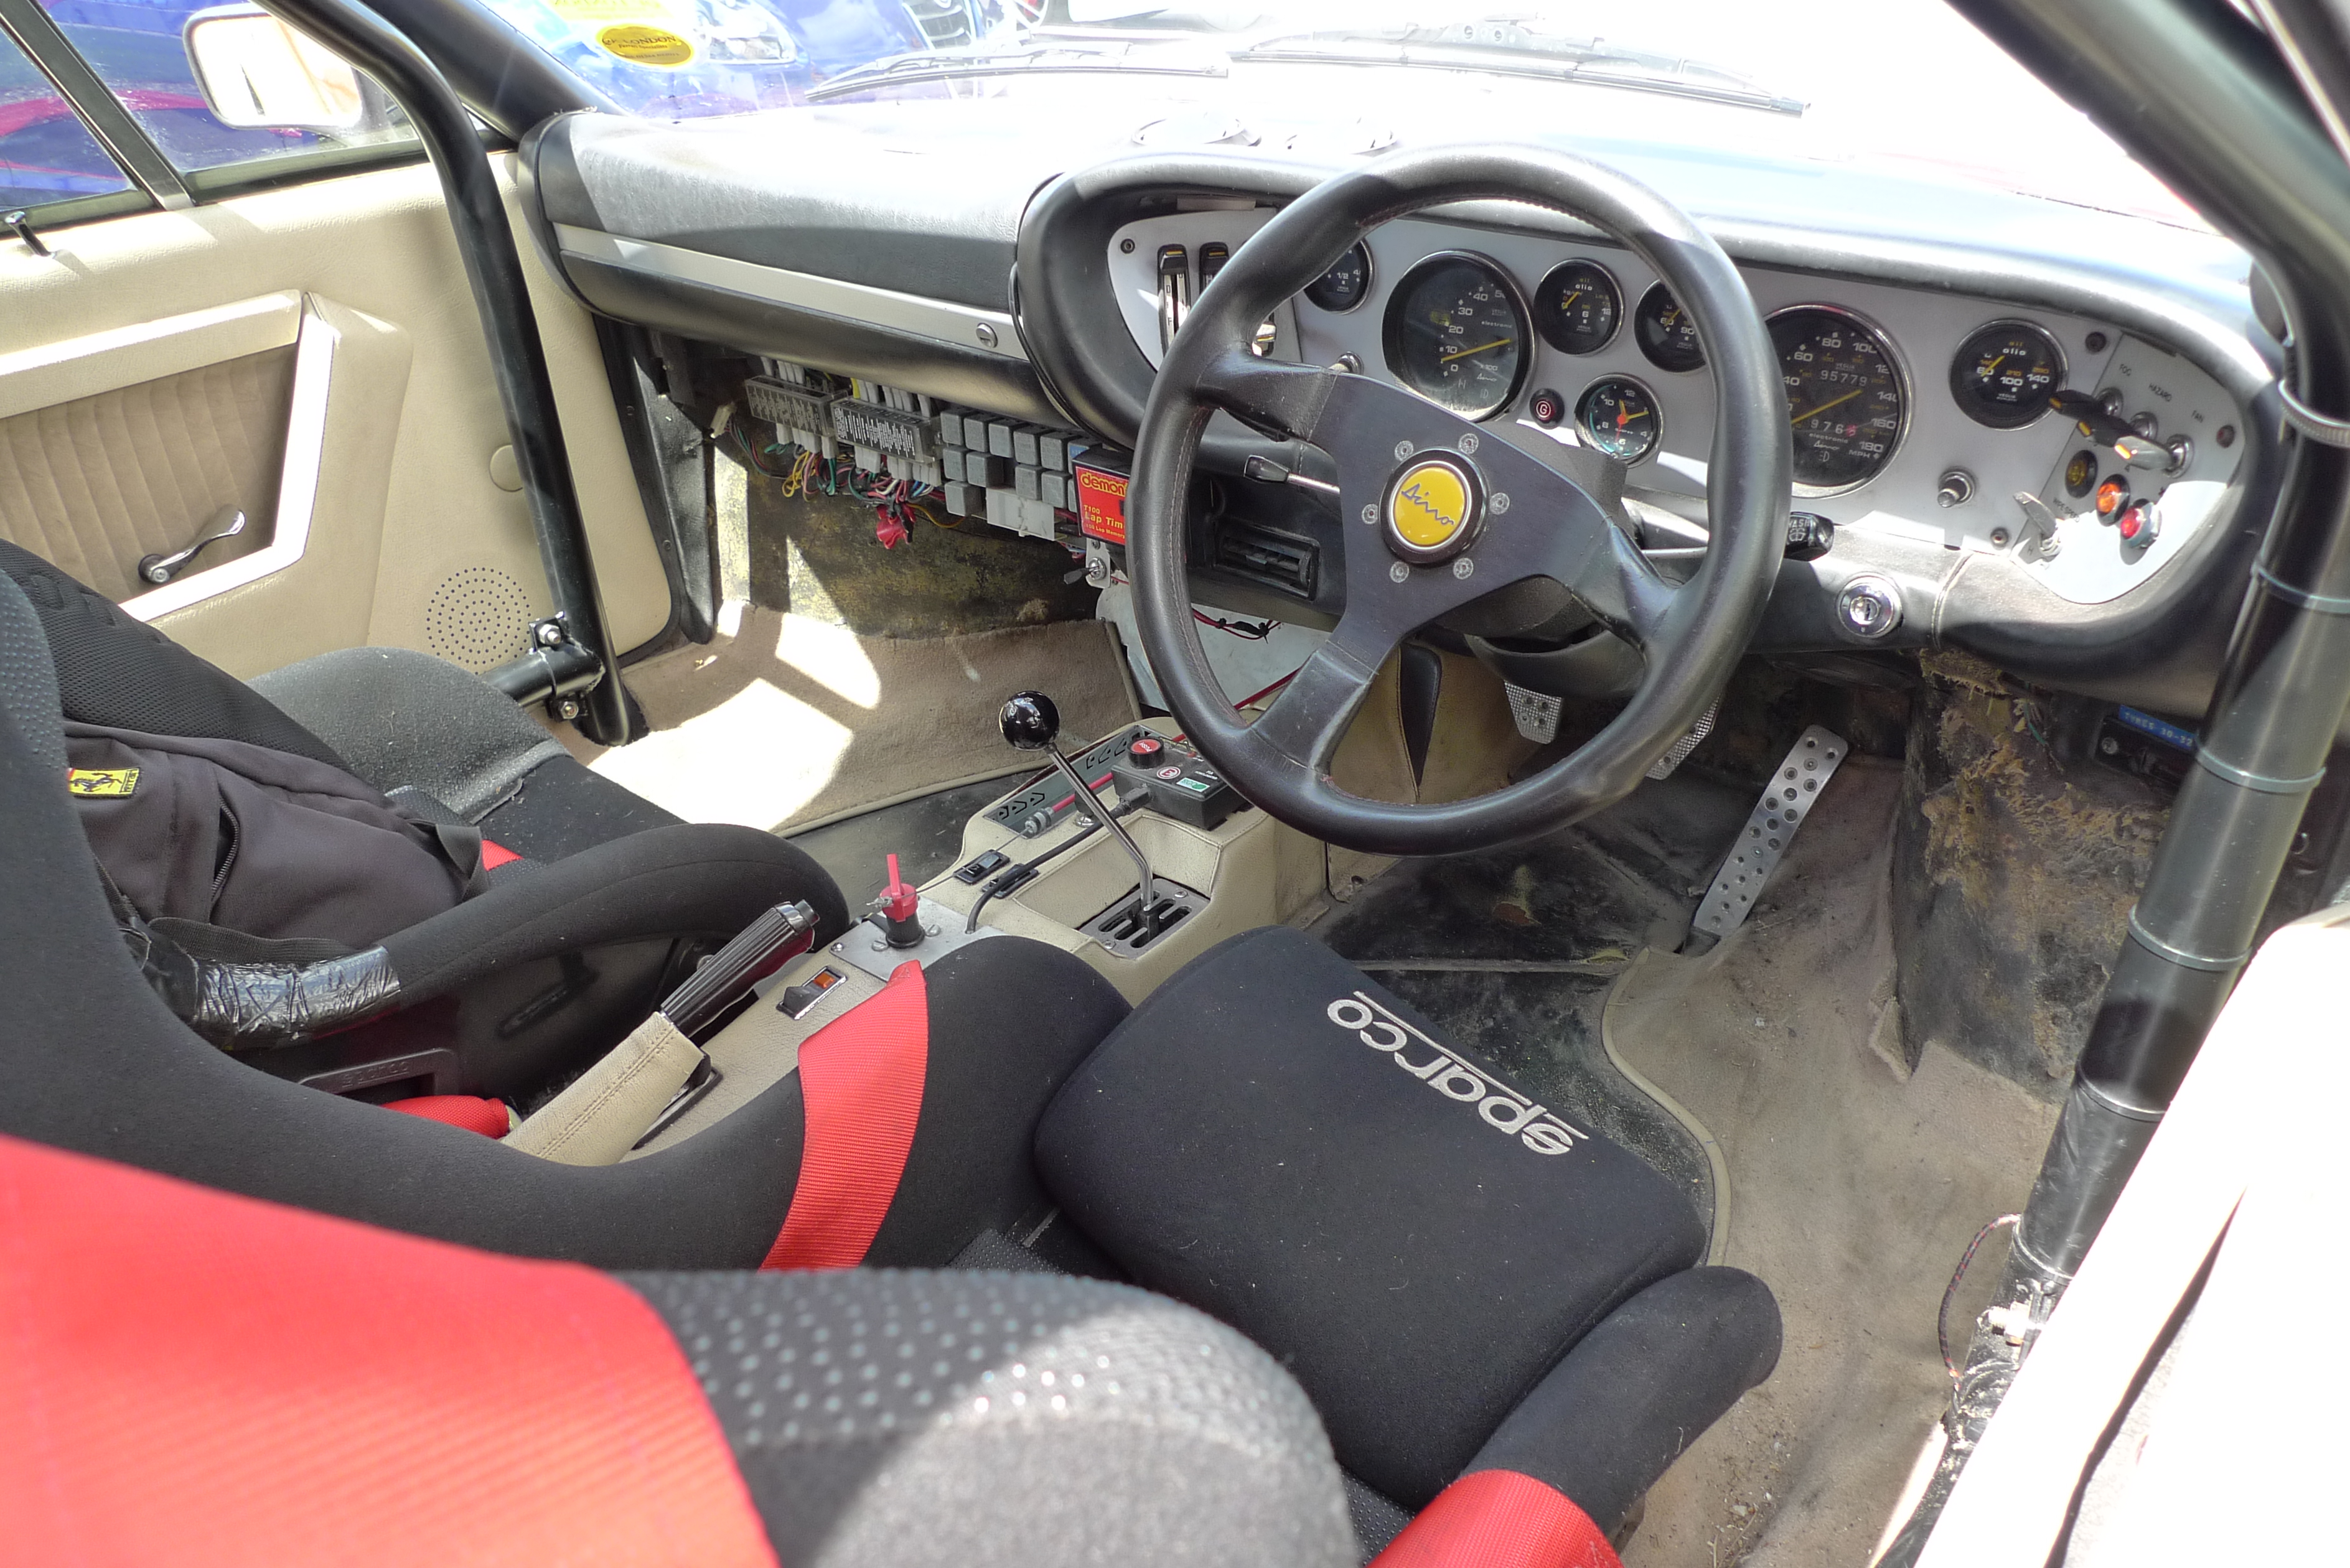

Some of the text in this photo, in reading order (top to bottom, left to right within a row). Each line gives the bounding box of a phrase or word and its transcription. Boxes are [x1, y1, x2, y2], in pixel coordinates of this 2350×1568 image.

[1473, 293, 1488, 301] 40
[1458, 307, 1472, 315] 30
[1448, 325, 1463, 334] 20
[1481, 320, 1512, 329] electronic
[1680, 327, 1694, 335] 90
[1822, 338, 1841, 348] 80
[1445, 345, 1457, 353] 10
[1794, 352, 1813, 362] 60
[1783, 376, 1800, 386] 40
[1820, 370, 1866, 386] 95779
[2000, 376, 2023, 386] 100
[2026, 373, 2049, 383] 140
[1624, 390, 1636, 398] 12
[2148, 383, 2173, 402] HAZARD
[1604, 398, 1614, 406] 10
[1539, 404, 1548, 414] G
[2191, 410, 2204, 423] FAN
[1871, 418, 1896, 429] 160
[1809, 432, 1848, 443] electronic
[1814, 441, 1840, 450] Dino
[1859, 441, 1883, 452] 180
[1849, 450, 1870, 459] MPH
[1401, 483, 1454, 526] Dino
[1084, 505, 1100, 515] T100
[1085, 511, 1124, 529] Lap Tim
[1327, 999, 1574, 1155] sparco
